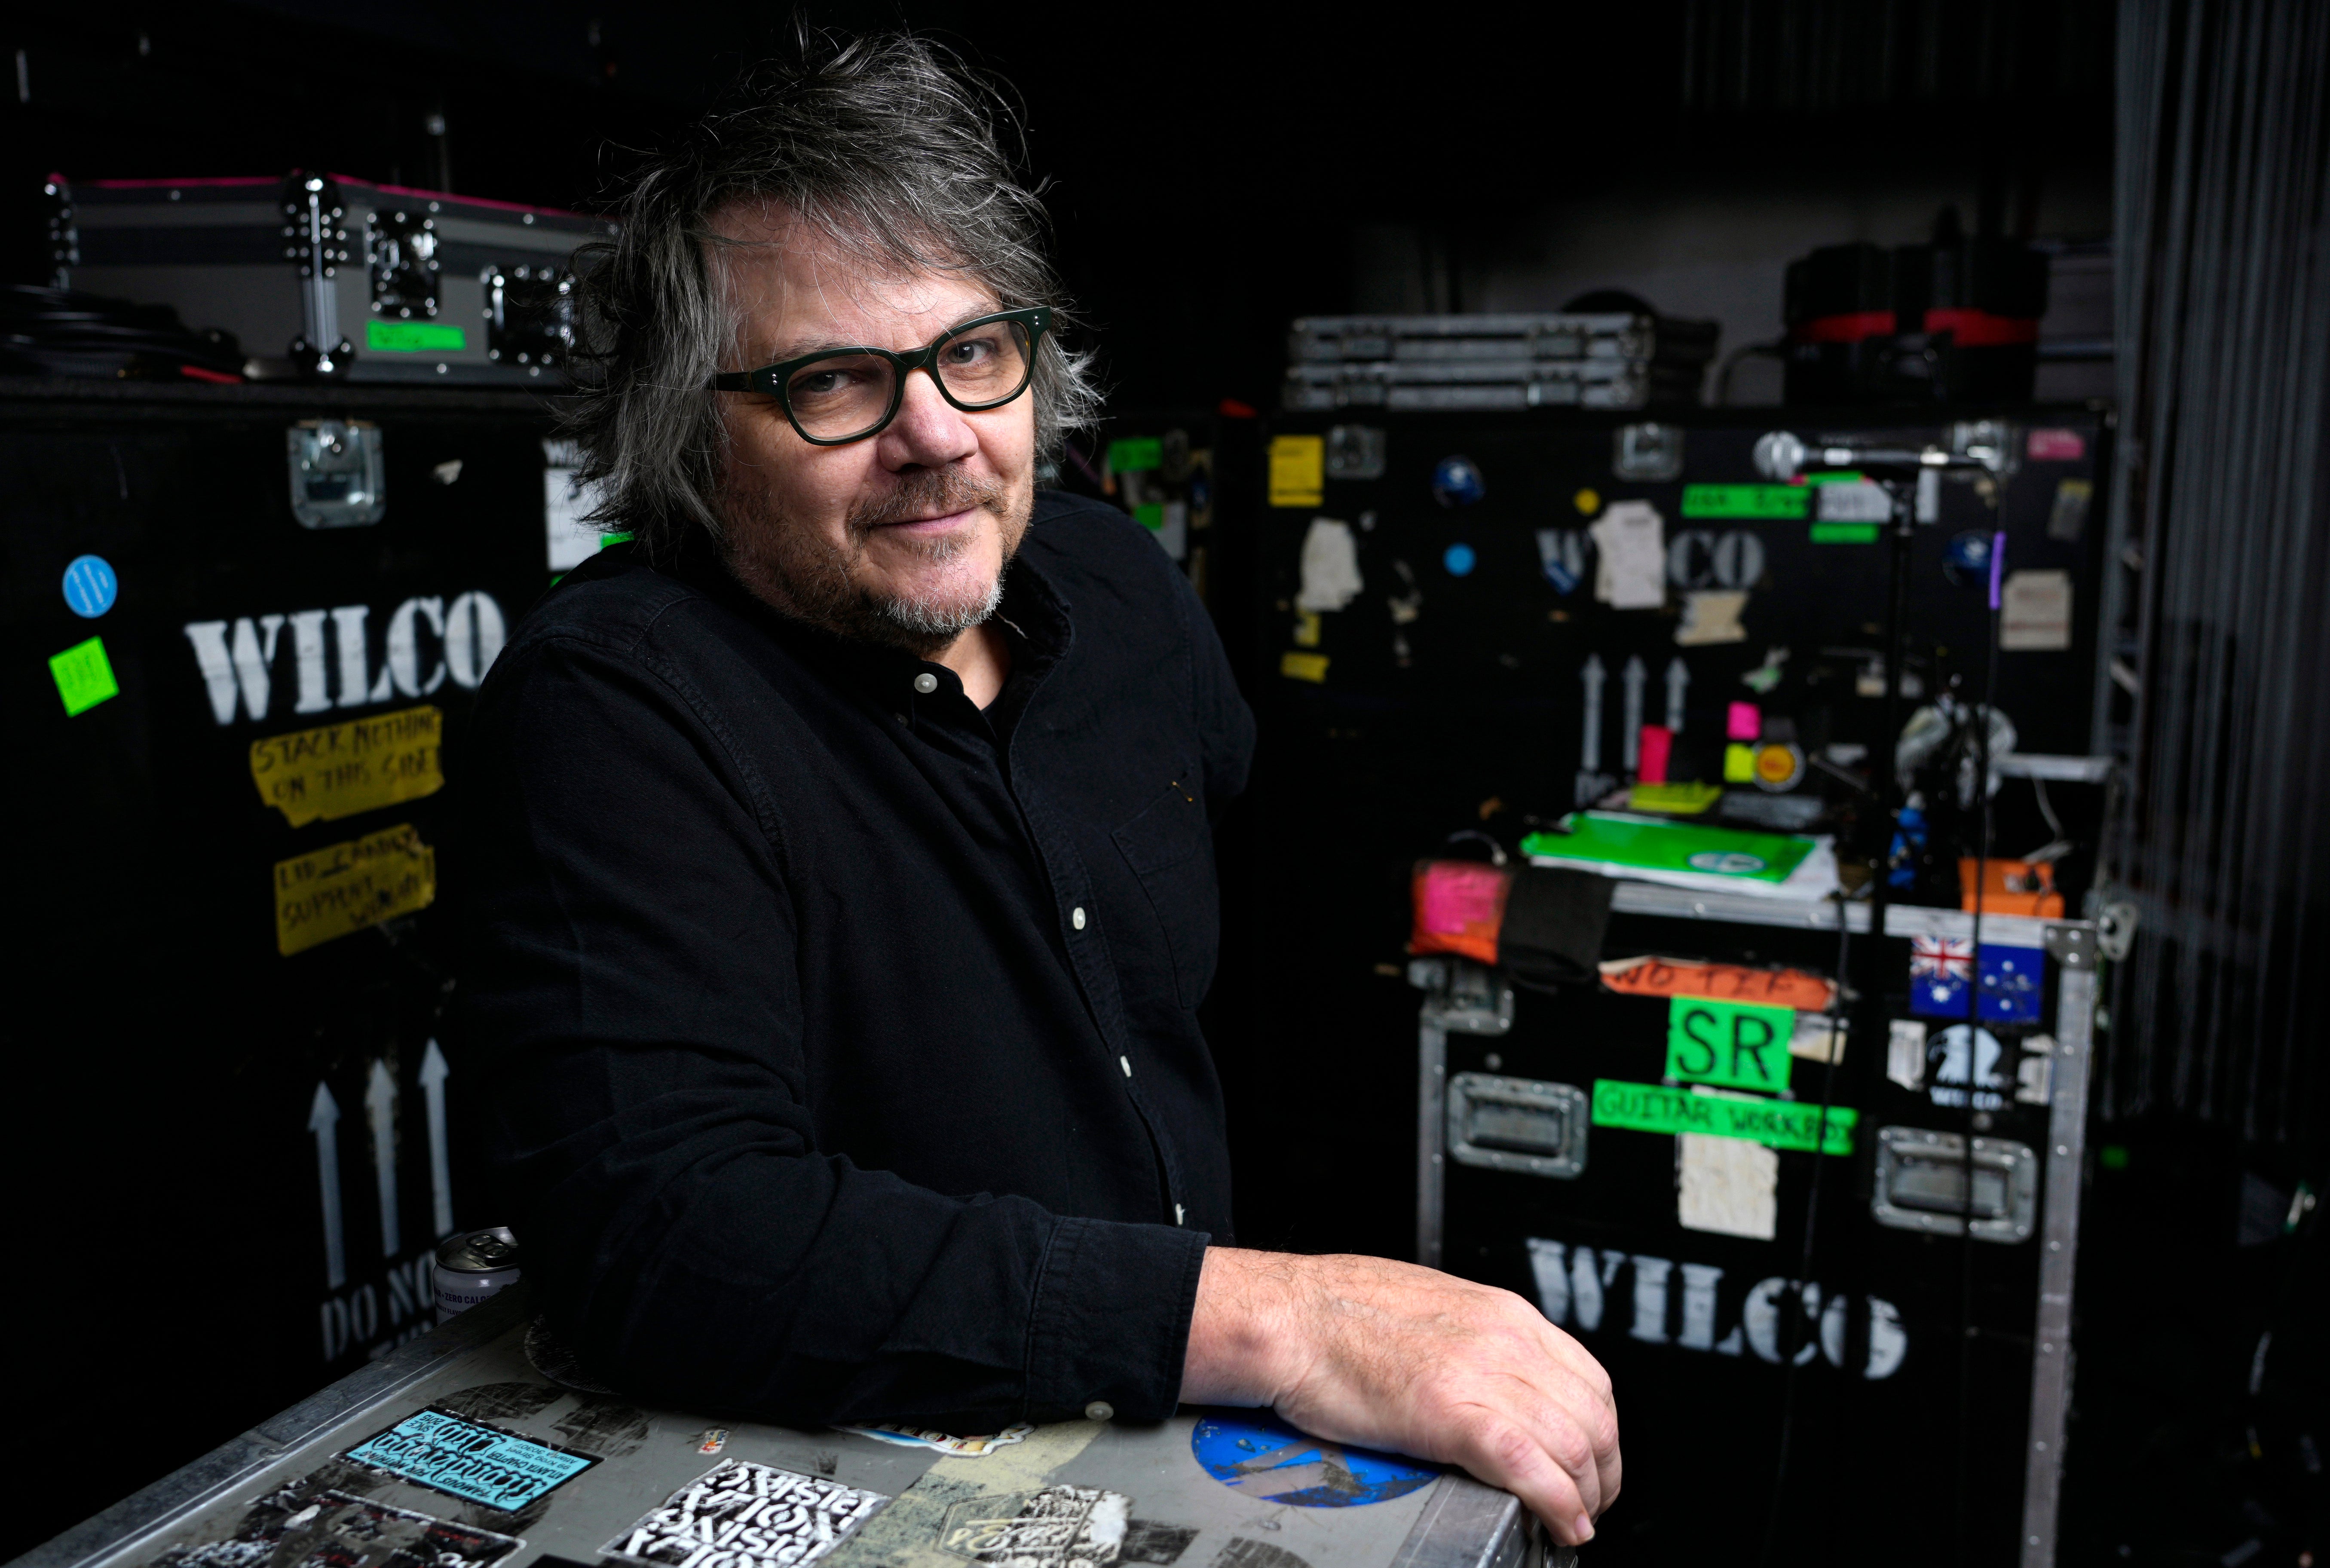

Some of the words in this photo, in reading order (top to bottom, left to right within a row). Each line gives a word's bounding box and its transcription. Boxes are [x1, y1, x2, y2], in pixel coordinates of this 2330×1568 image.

[1534, 527, 1765, 590] WCO
[184, 591, 506, 725] WILCO
[258, 726, 344, 771] STACK
[1678, 1010, 1775, 1081] SR
[1595, 1084, 1713, 1129] GUITAR
[445, 1292, 462, 1303] ZERO
[1527, 1237, 1907, 1379] WILCO
[320, 1284, 378, 1362] DO
[405, 1420, 435, 1432] SINCE
[418, 1414, 446, 1425] 2015
[433, 1422, 505, 1455] Club
[514, 1442, 547, 1454] 30307
[484, 1451, 531, 1468] CHAPTER
[503, 1447, 536, 1458] Street
[532, 1455, 560, 1466] Krog
[523, 1463, 567, 1479] ATLANTA
